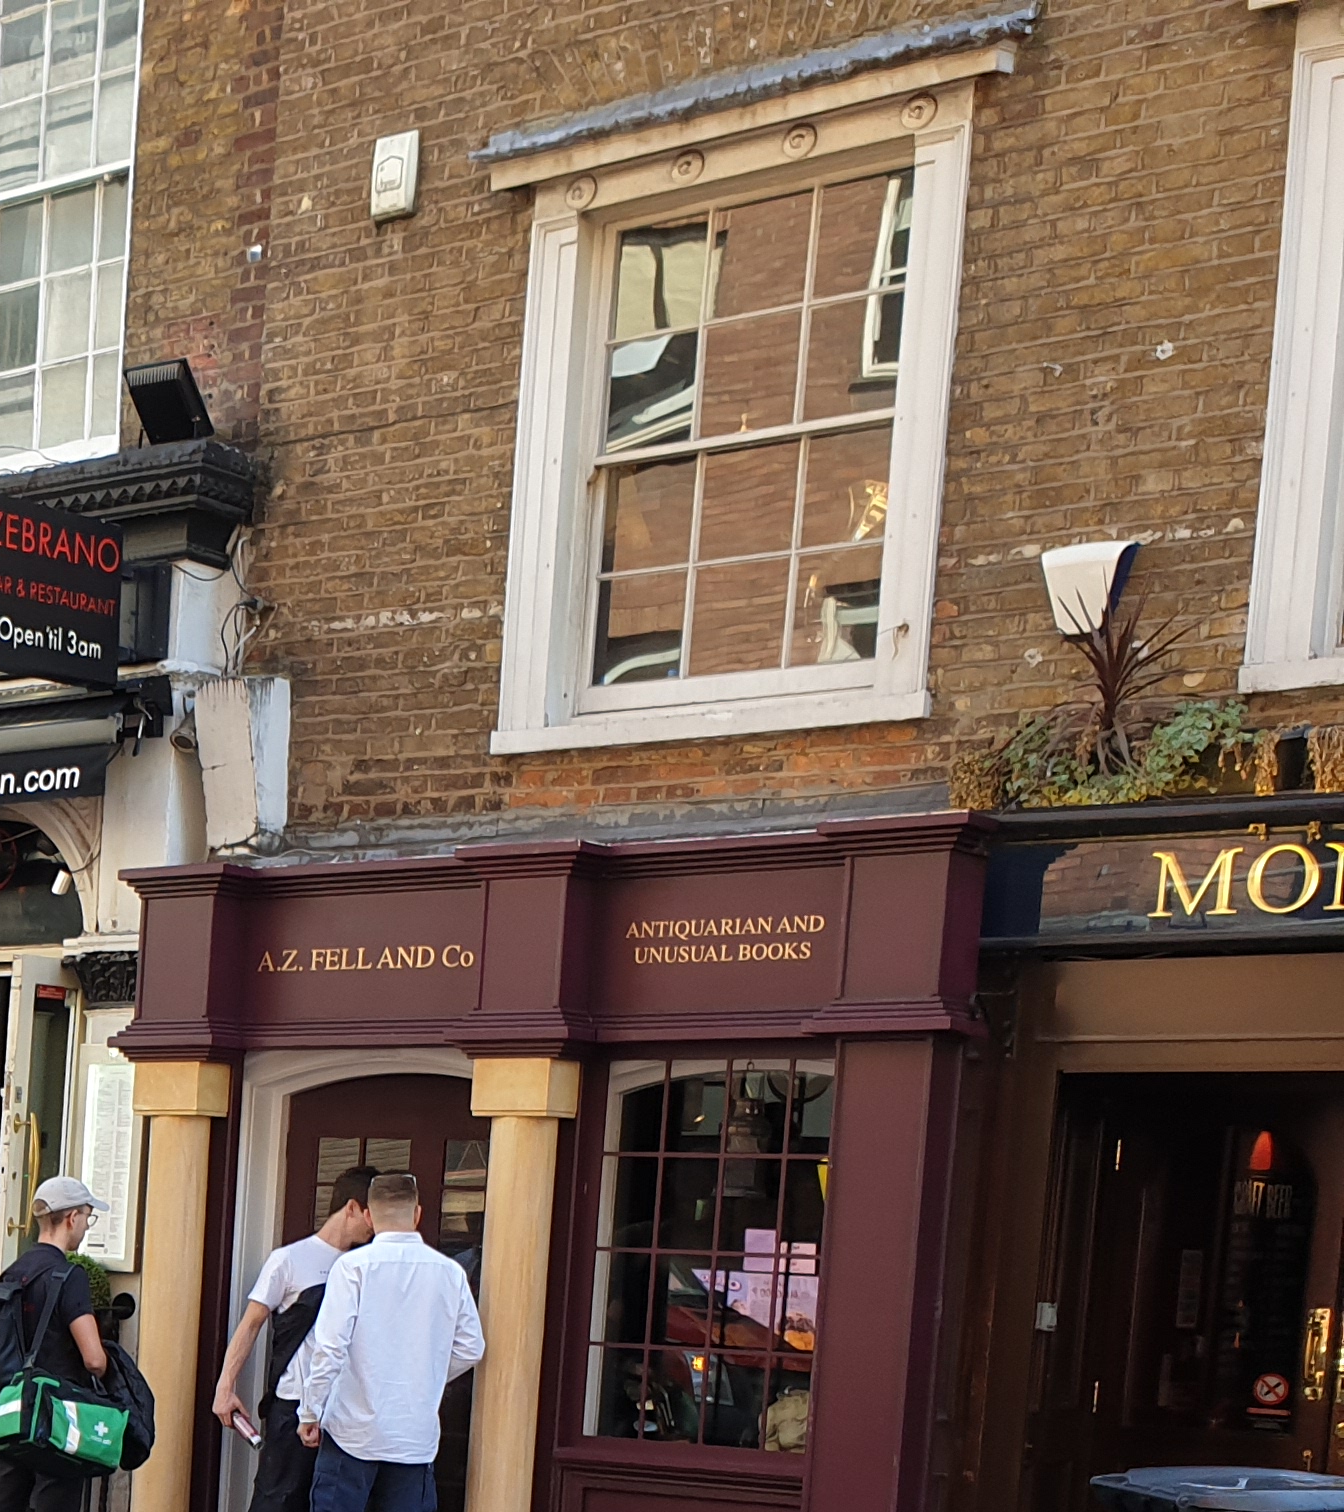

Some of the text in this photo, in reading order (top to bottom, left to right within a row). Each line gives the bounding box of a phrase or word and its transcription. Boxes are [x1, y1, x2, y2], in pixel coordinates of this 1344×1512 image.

[16, 578, 26, 598] &
[29, 581, 116, 617] RESTAURANT
[67, 629, 102, 660] 3am
[626, 915, 825, 940] ANTIQUARIAN AND
[257, 945, 474, 972] A.Z. FELL AND Co
[634, 941, 812, 964] UNUSUAL BOOKS
